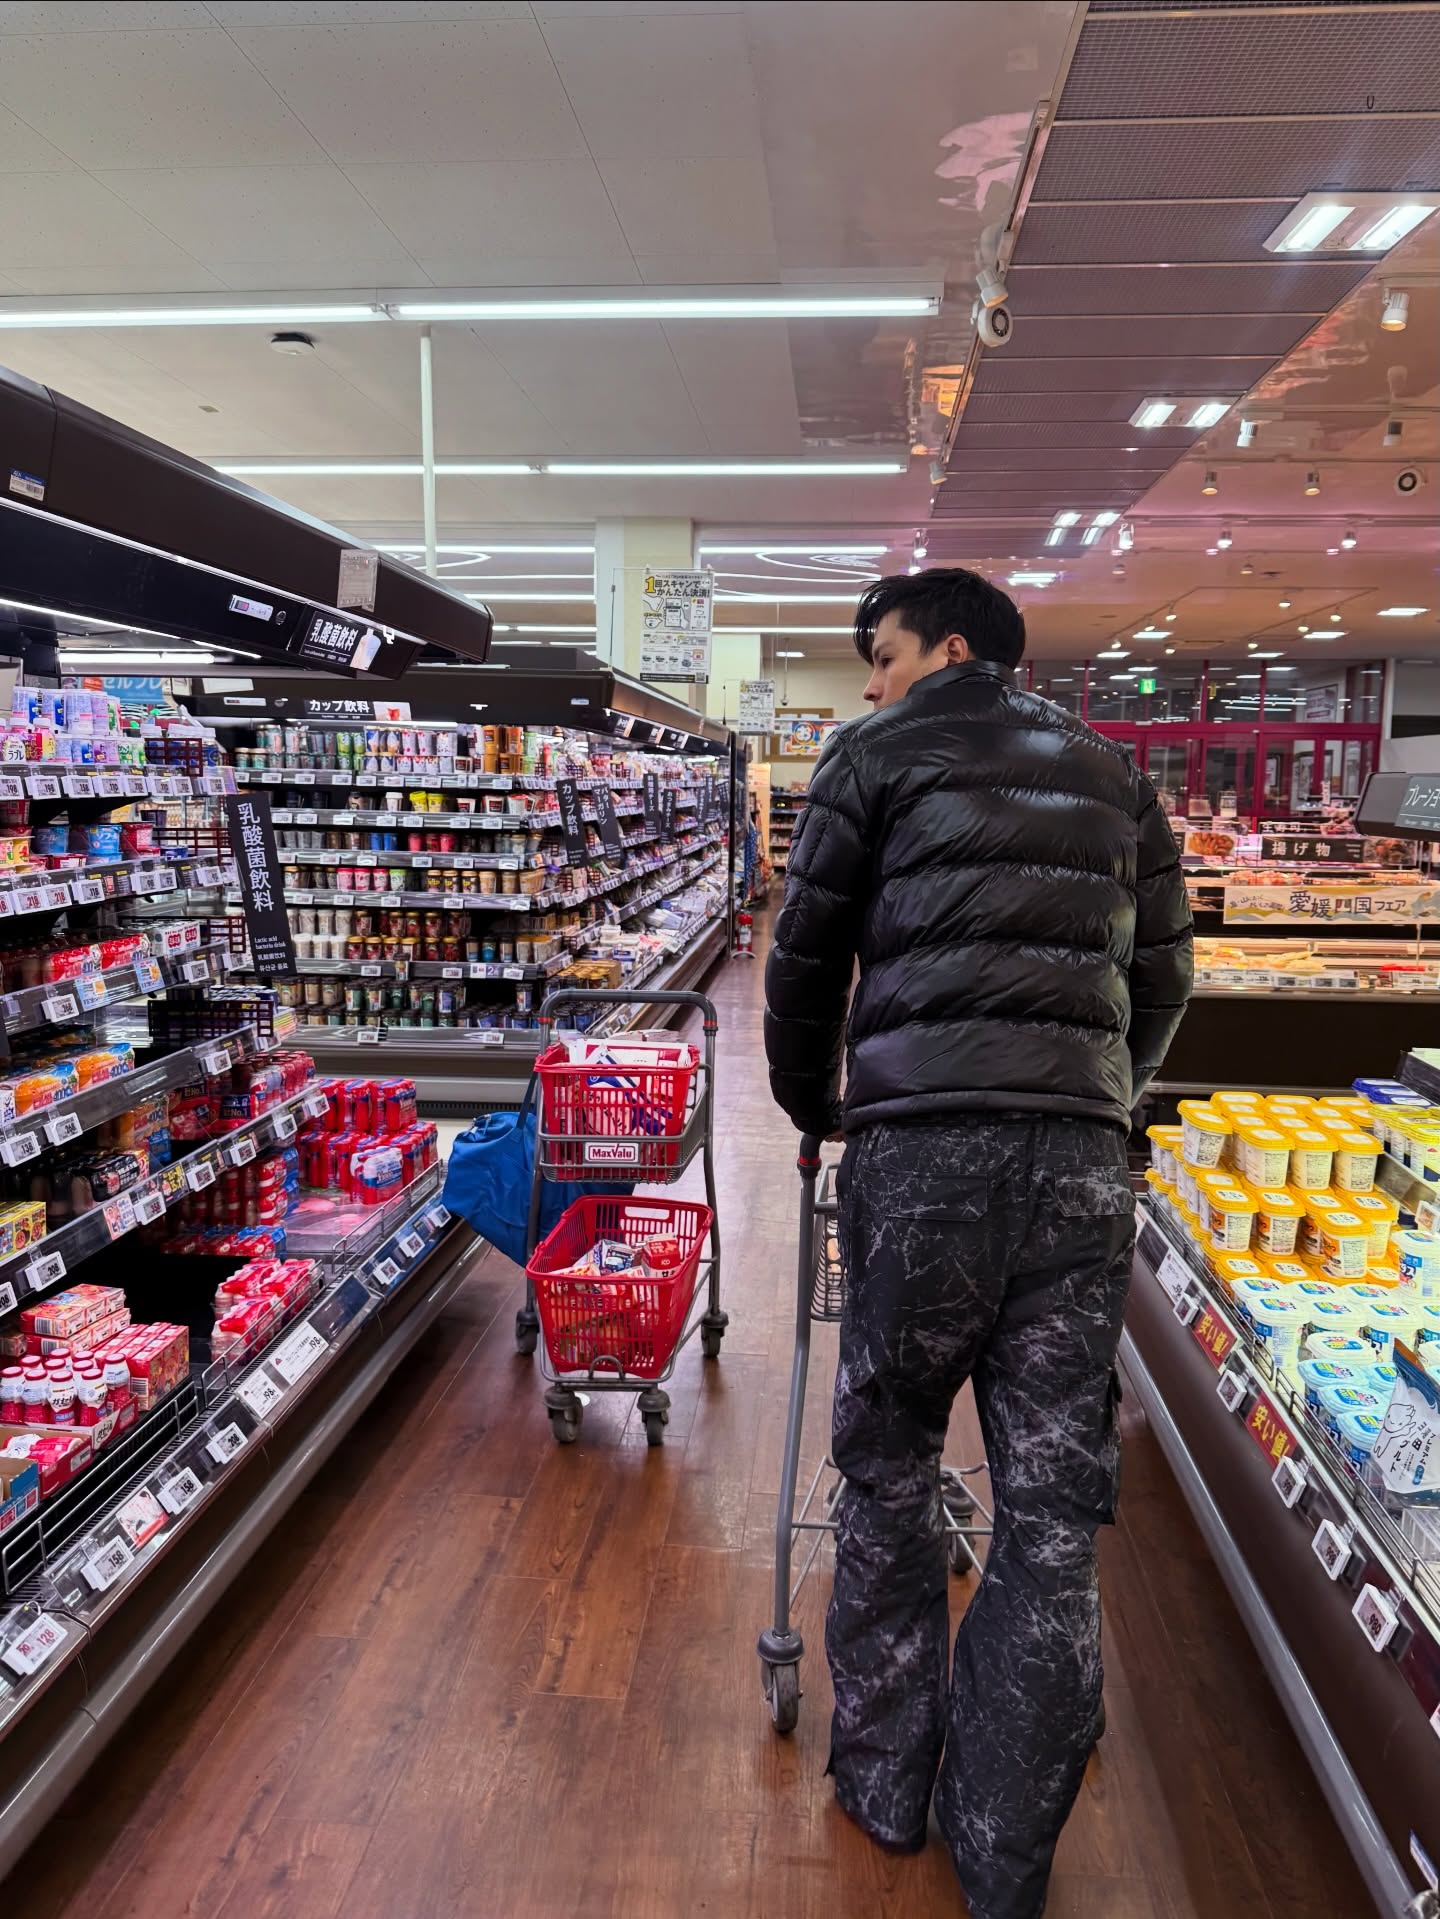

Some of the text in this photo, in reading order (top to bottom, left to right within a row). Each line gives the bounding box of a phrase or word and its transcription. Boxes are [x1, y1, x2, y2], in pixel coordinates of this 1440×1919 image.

[300, 619, 359, 651] 乳酸菌飲料
[309, 699, 370, 713] カップ飲料
[237, 802, 275, 912] 乳酸菌飲料
[1271, 841, 1331, 857] 揚げ物
[592, 1143, 632, 1158] MaxValu
[1199, 1313, 1230, 1357] 安い値!
[180, 1479, 195, 1495] 158
[108, 1549, 125, 1568] 158
[37, 1628, 55, 1646] 128
